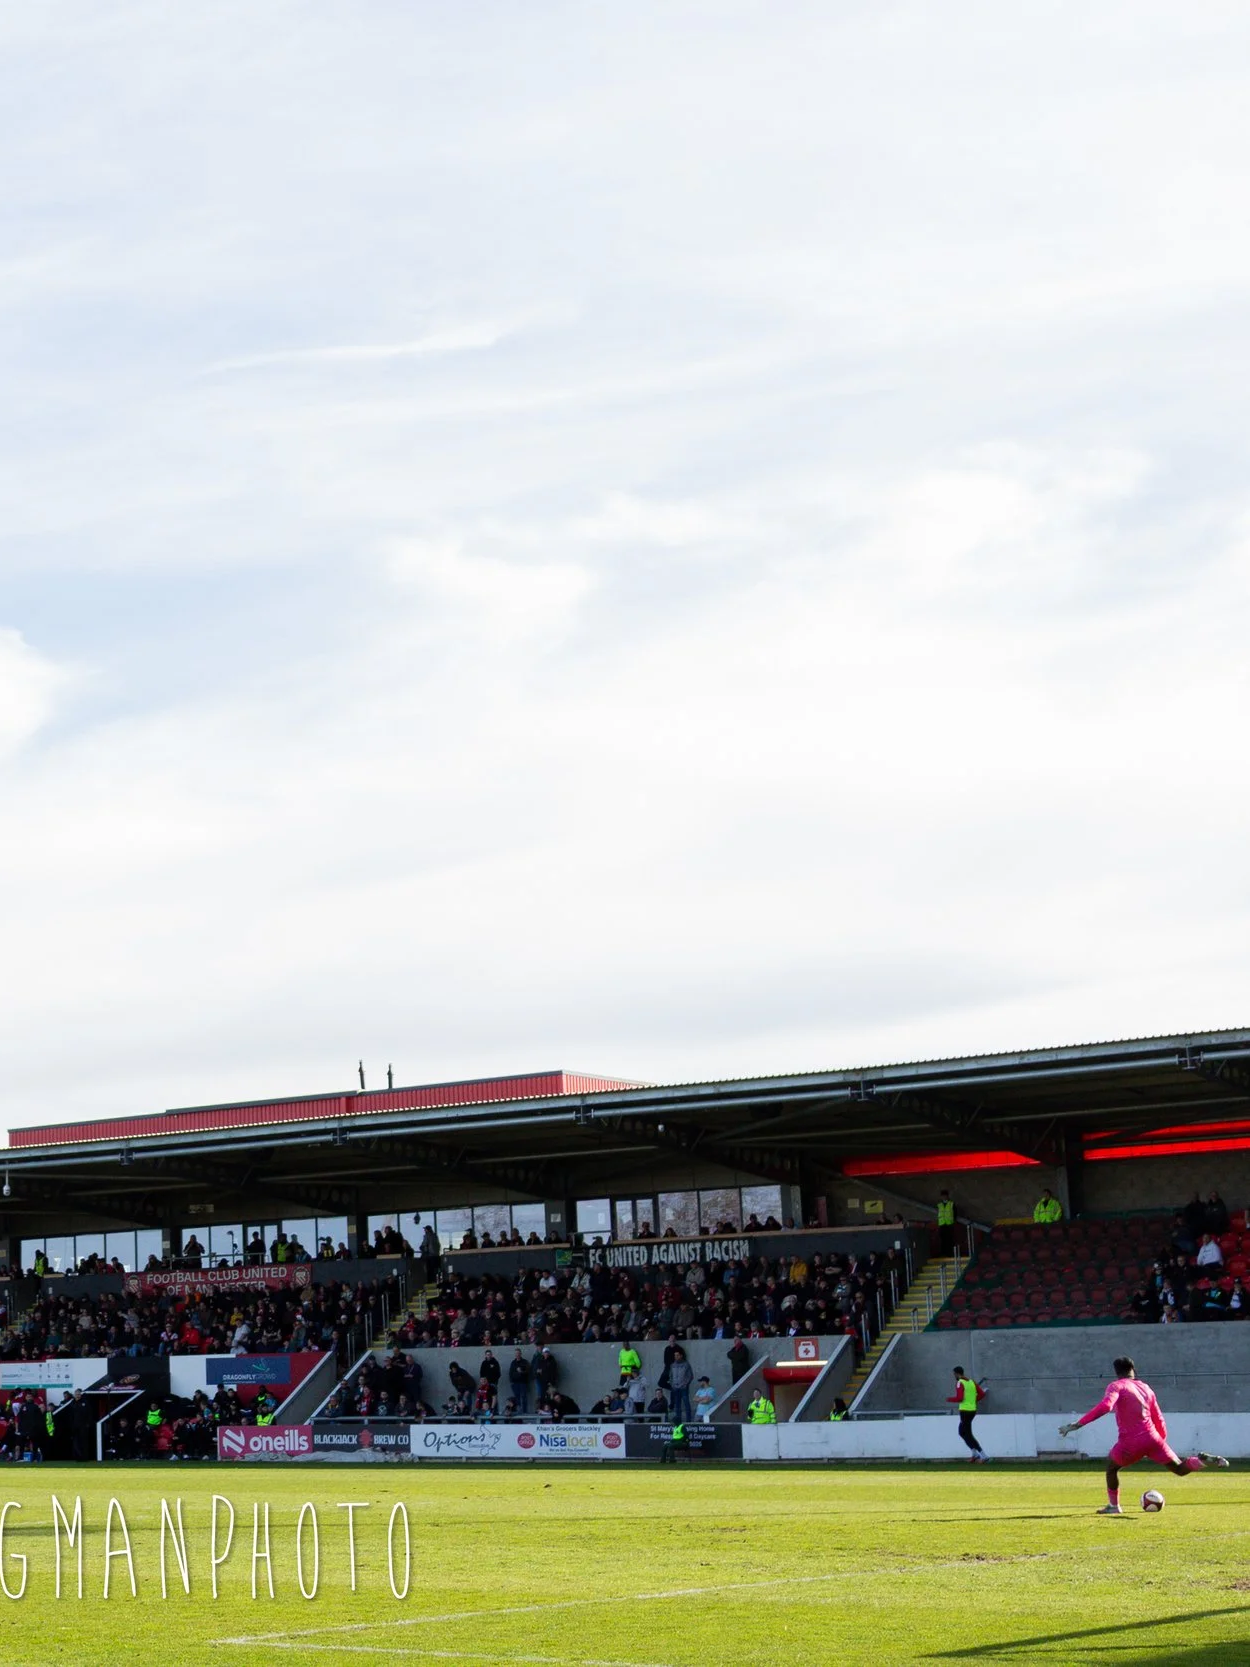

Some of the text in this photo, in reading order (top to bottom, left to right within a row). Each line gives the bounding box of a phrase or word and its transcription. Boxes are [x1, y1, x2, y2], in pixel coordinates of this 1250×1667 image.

[589, 1240, 750, 1267] FC UNITED AGAINST RACISM
[147, 1267, 287, 1284] FOOTBALL CLUB UNITED
[167, 1281, 266, 1295] OF MANHESTER
[314, 1434, 409, 1445] BLACKJACK BREW CO
[423, 1432, 485, 1453] Options
